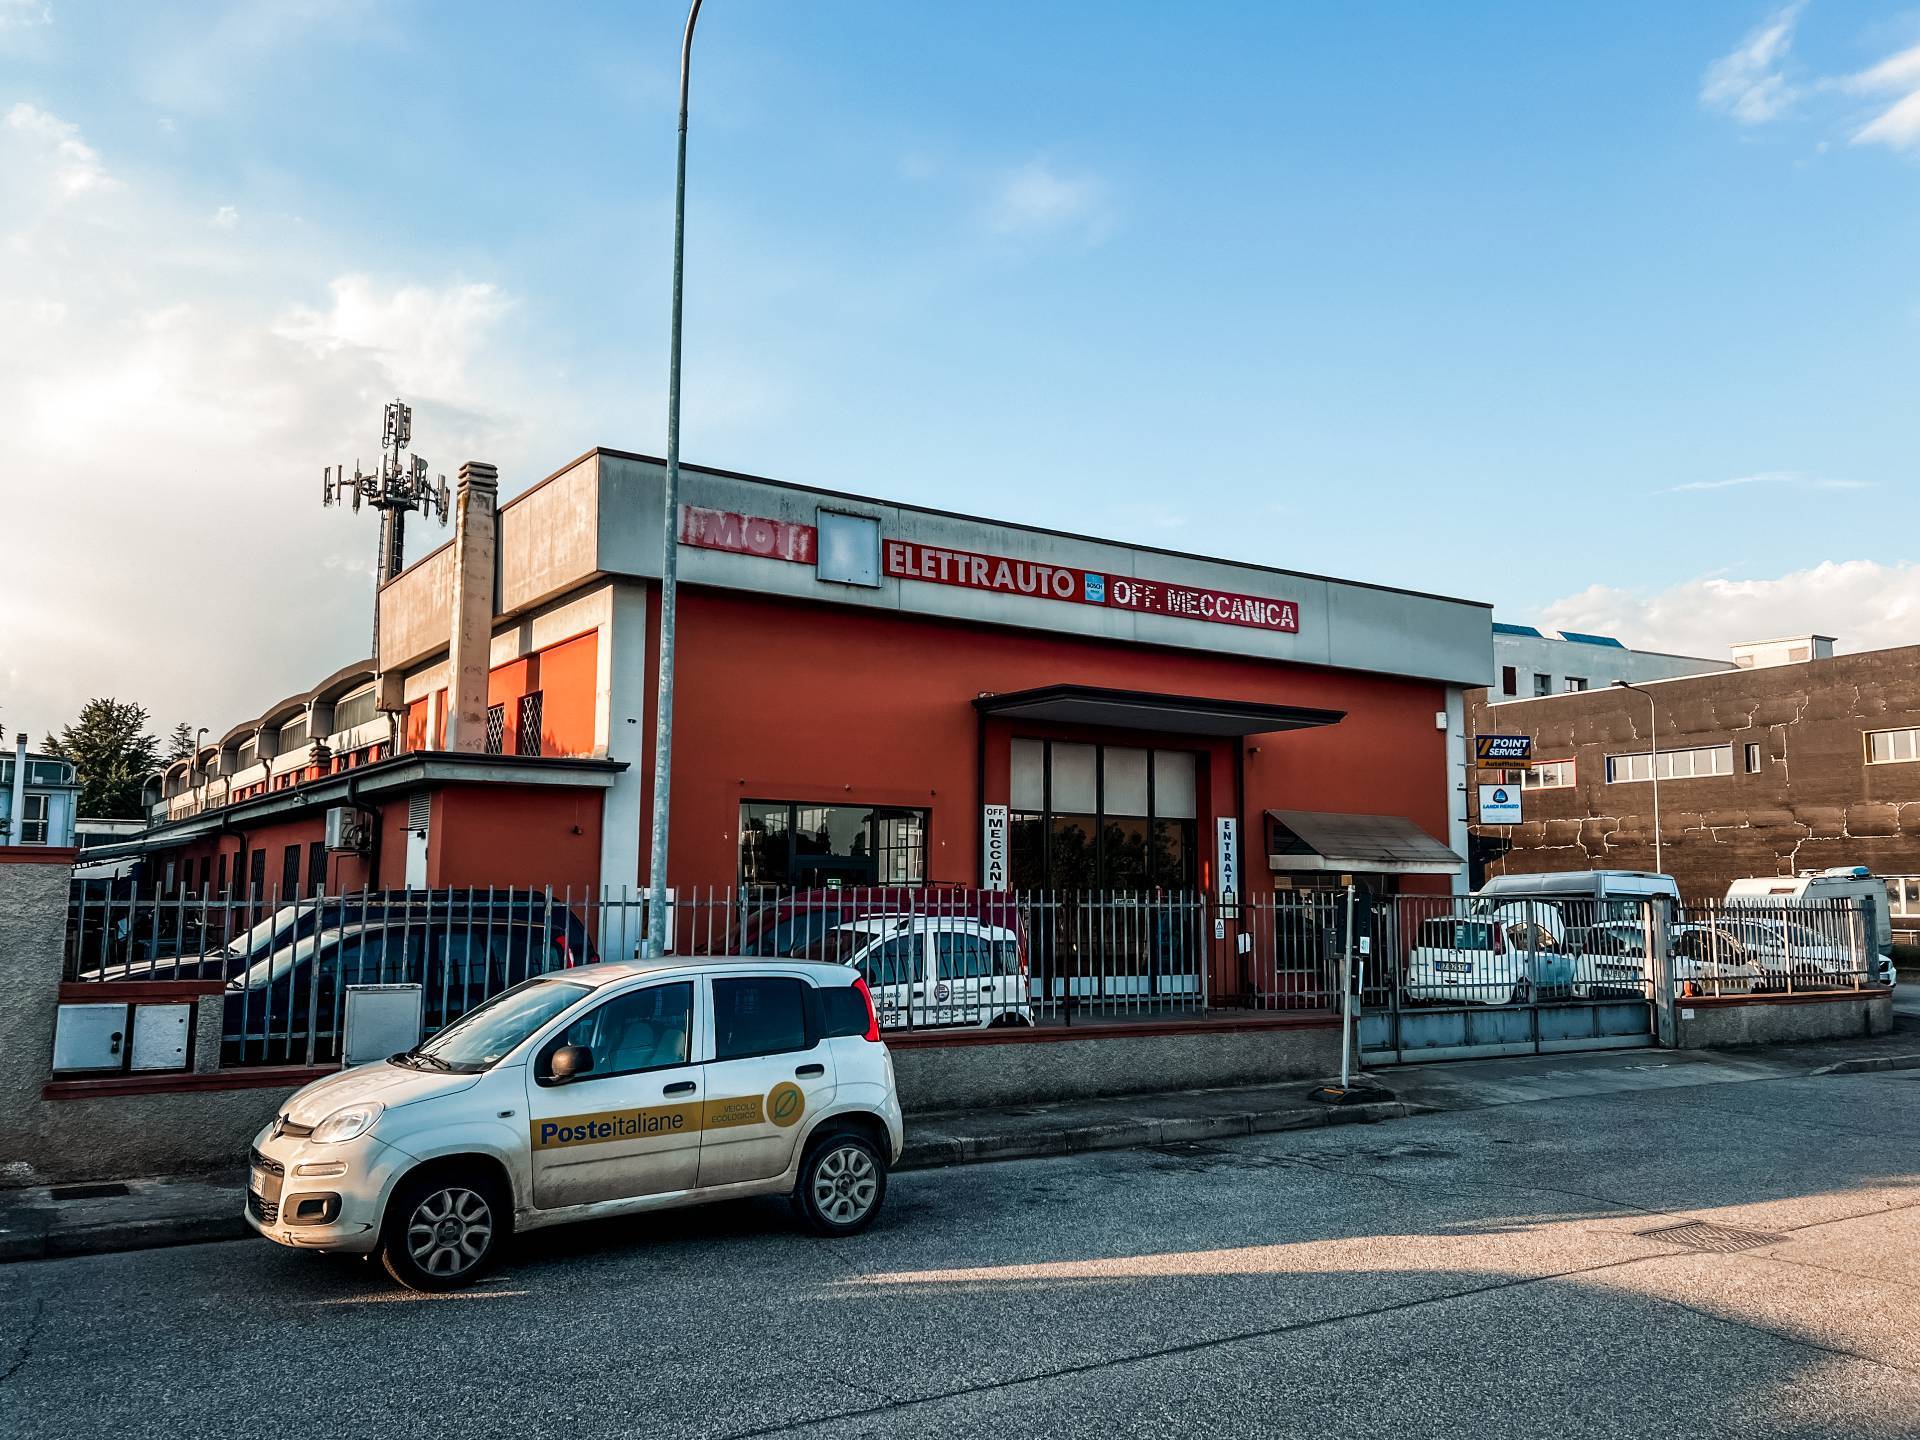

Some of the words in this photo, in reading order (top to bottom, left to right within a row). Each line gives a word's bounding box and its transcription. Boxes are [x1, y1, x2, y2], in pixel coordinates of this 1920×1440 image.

[889, 542, 1075, 598] ELETTRAUTO
[1113, 581, 1161, 609] OFF.
[1167, 588, 1295, 628] MECCANICA
[1492, 738, 1530, 748] POINT
[1488, 748, 1523, 756] SERVICE
[986, 808, 1006, 816] OFF.
[1223, 820, 1233, 894] ENTRATA
[724, 1102, 756, 1113] VEICOLO
[711, 1110, 756, 1123] ECOLOGICO
